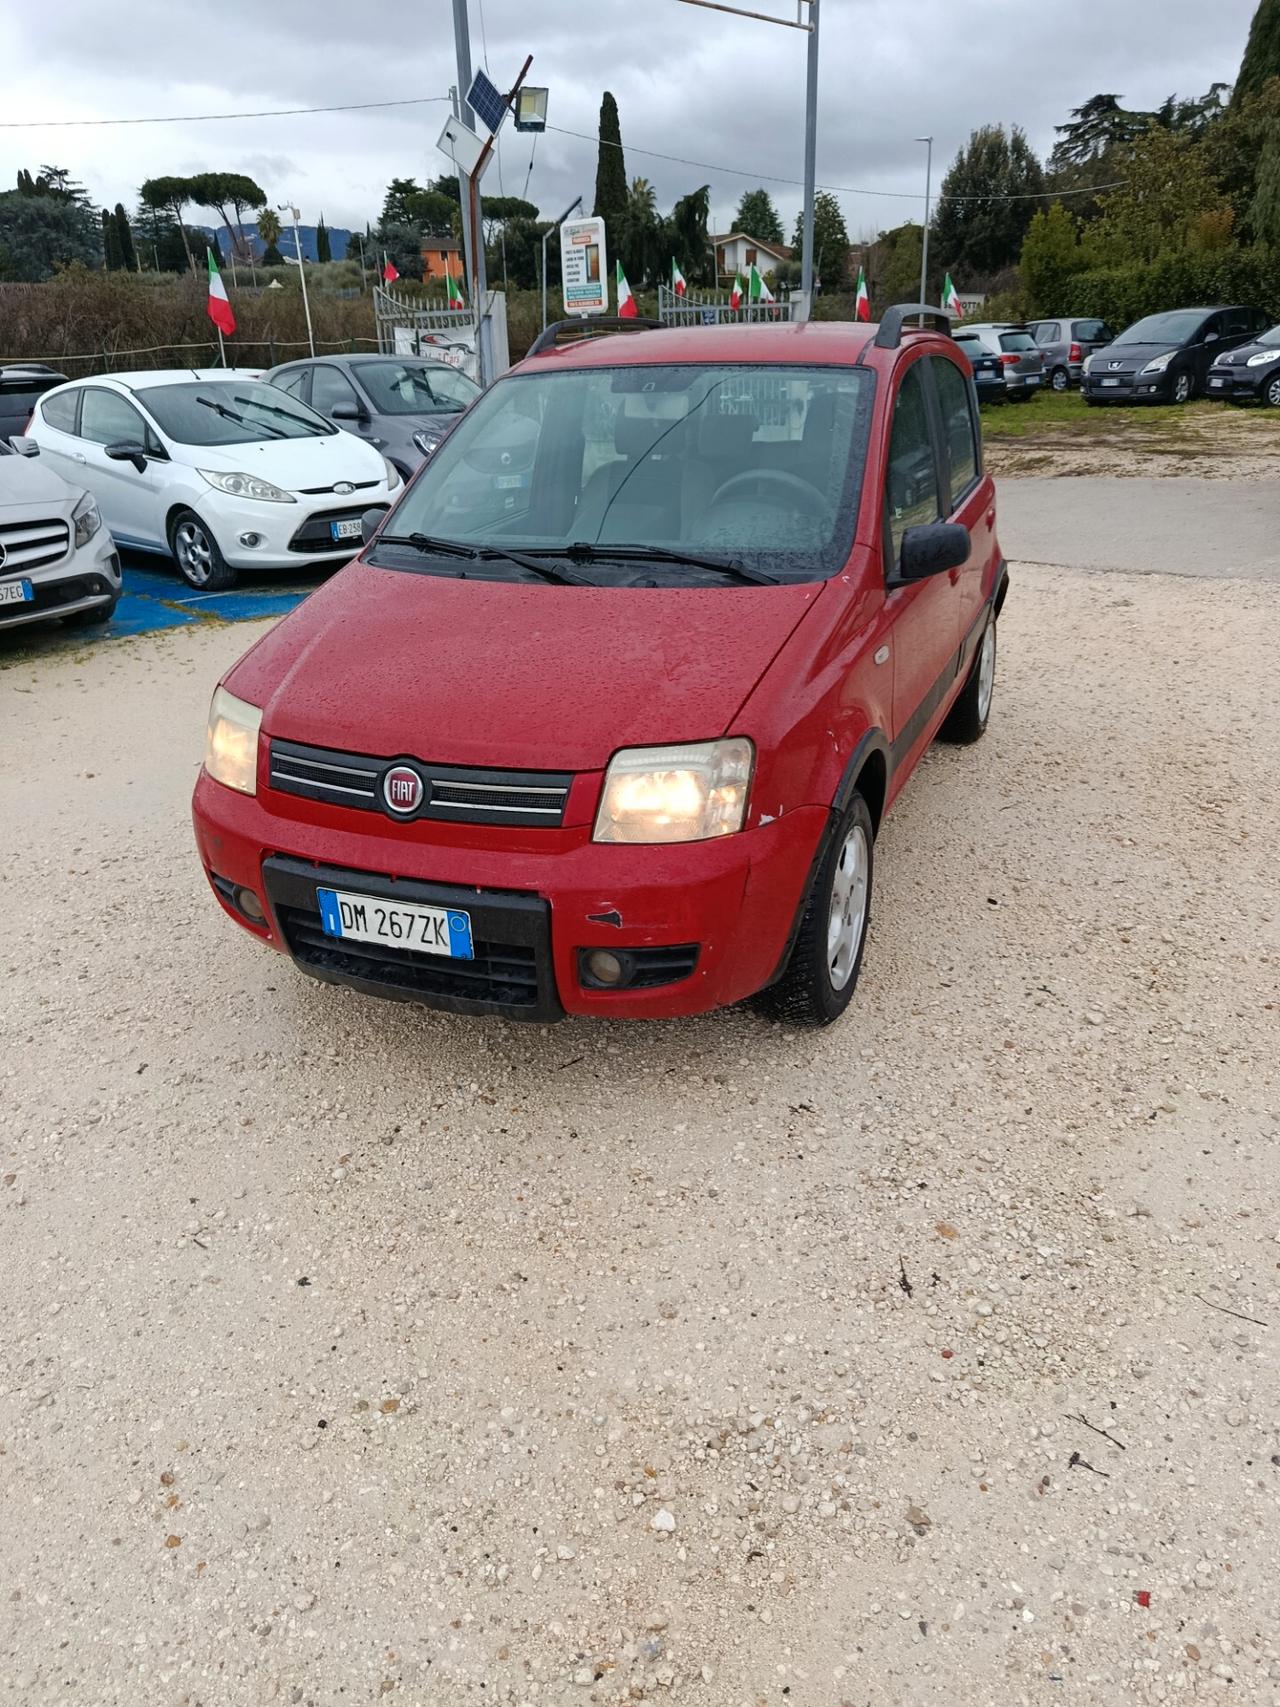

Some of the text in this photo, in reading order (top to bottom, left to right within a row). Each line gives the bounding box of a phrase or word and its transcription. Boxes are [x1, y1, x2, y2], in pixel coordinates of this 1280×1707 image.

[392, 780, 415, 801] FIAT
[340, 901, 368, 933] DM
[374, 908, 448, 947] 267ZK
